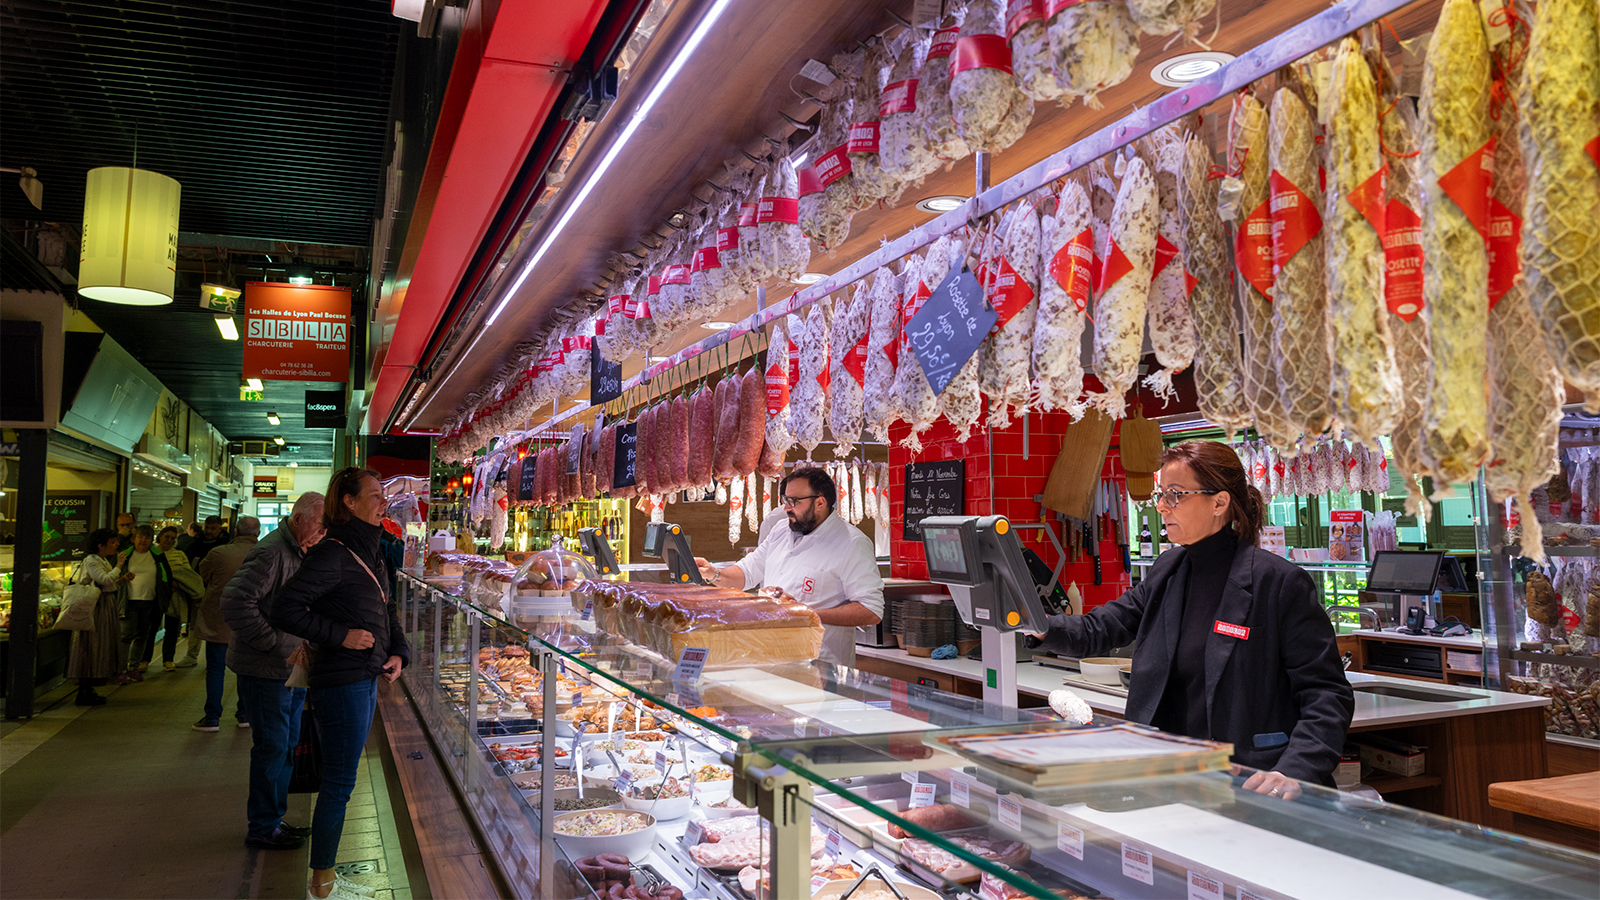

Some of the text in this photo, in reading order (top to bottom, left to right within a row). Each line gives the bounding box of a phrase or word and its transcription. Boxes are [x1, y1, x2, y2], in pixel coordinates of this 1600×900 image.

[946, 276, 977, 336] Rosette de
[248, 320, 346, 342] SIBILIA
[936, 310, 954, 341] Lyon
[262, 368, 331, 376] charcuterie-sibilia.com
[804, 580, 812, 591] S
[1192, 876, 1218, 894] SIBILIA
